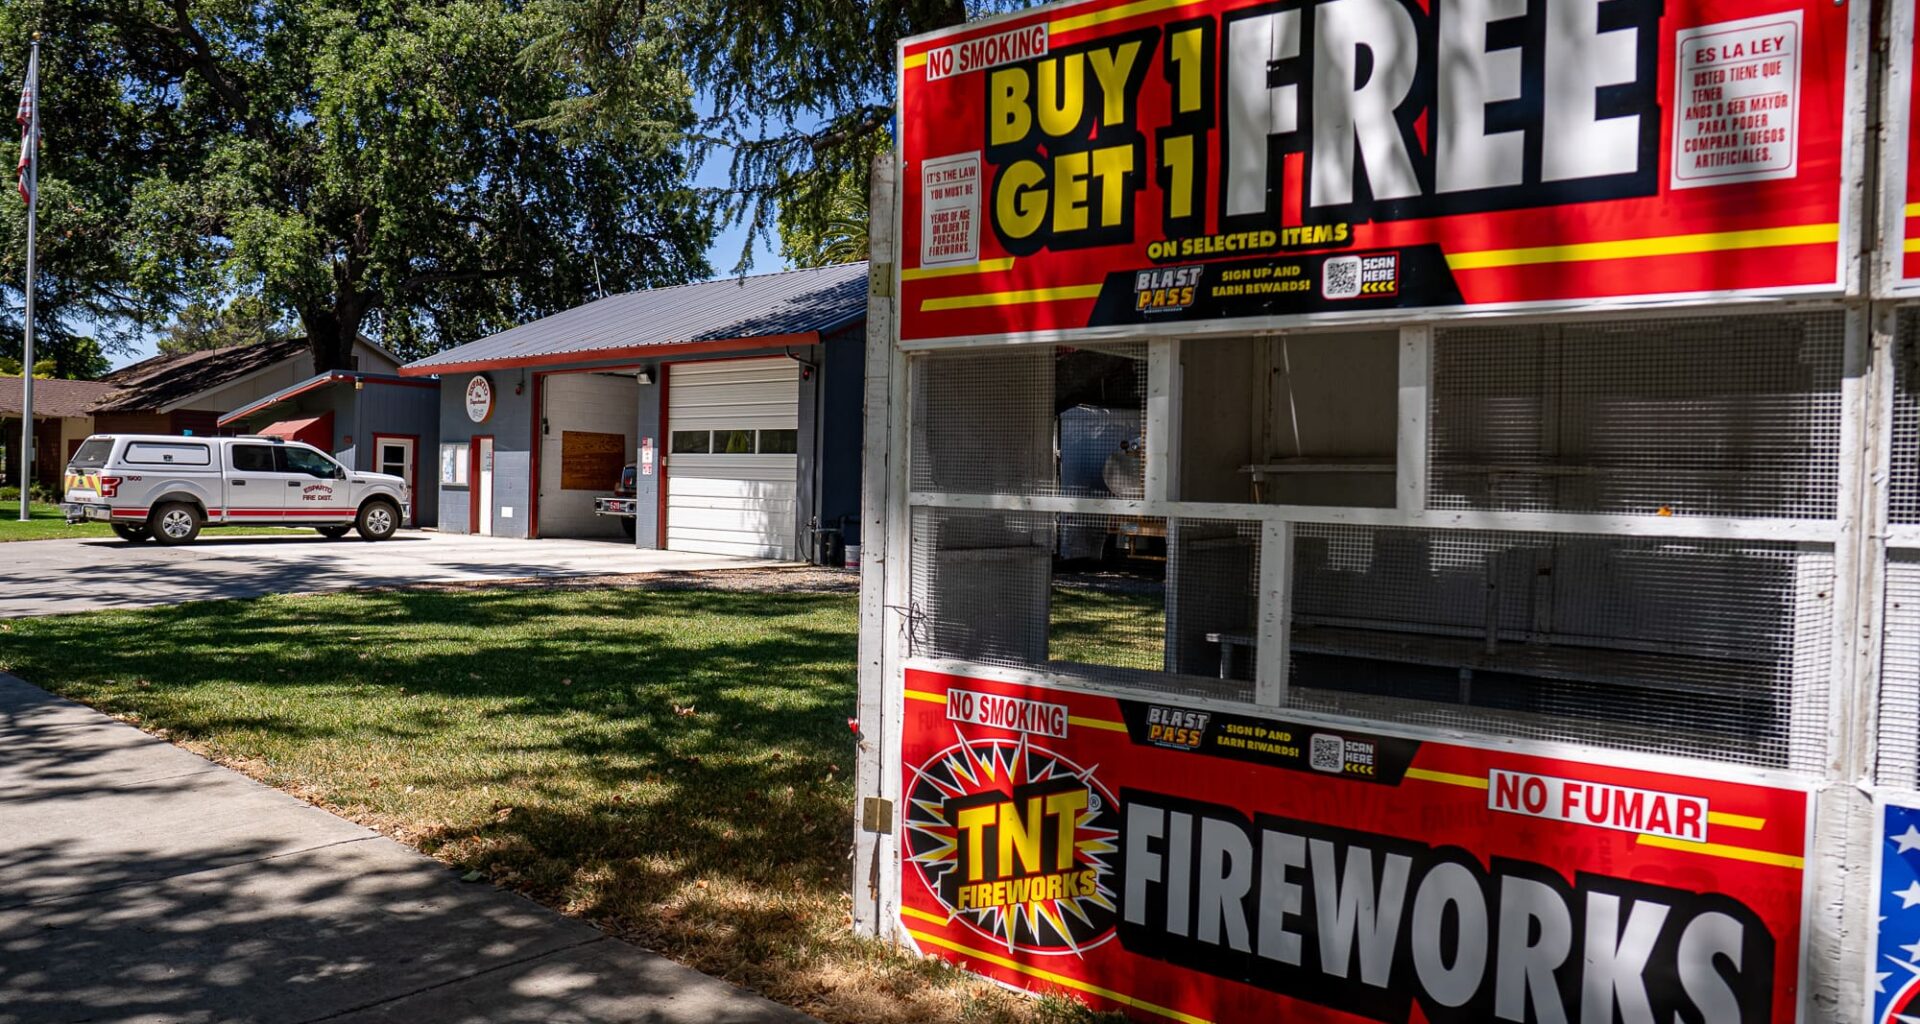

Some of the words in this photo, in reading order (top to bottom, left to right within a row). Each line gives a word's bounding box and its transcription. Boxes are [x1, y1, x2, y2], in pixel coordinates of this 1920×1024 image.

[928, 52, 954, 80] NO
[959, 27, 1045, 70] SMOKING
[1695, 47, 1716, 64] ES
[1723, 43, 1743, 59] LA
[1752, 36, 1785, 55] LEY
[1694, 70, 1725, 87] USTED
[1730, 64, 1758, 82] TIENE
[1763, 61, 1782, 79] QUE
[990, 40, 1142, 146] BUY
[1171, 27, 1203, 114] 1
[1692, 87, 1722, 103] TENER
[1226, 0, 1640, 217] FREE
[1727, 100, 1745, 116] SER
[1750, 94, 1788, 112] MAYOR
[1698, 118, 1727, 135] PARA
[1732, 114, 1768, 131] PODER
[1684, 133, 1738, 153] COMPRAR
[1743, 128, 1785, 146] FUEGOS
[927, 171, 941, 184] IT'S
[943, 169, 957, 181] THE
[959, 165, 976, 179] LAW
[931, 188, 942, 200] YOU
[945, 185, 963, 198] MUST
[966, 183, 973, 195] BE
[996, 144, 1134, 240] GET
[1163, 134, 1194, 219] 1
[930, 212, 949, 224] YEARS
[951, 210, 958, 221] OF
[959, 209, 970, 220] AGE
[933, 224, 940, 234] OR
[942, 222, 959, 233] OLDER
[961, 220, 970, 231] TO
[933, 233, 969, 245] PURCHASE
[1148, 241, 1177, 260] ON
[1181, 230, 1276, 256] SELECTED
[1281, 223, 1348, 247] ITEMS
[1222, 268, 1251, 282] SIGN
[1253, 267, 1272, 279] UP
[1273, 265, 1301, 278] AND
[1362, 256, 1395, 269] SCAN
[1136, 267, 1202, 290] BLAST
[1362, 269, 1395, 282] HERE
[1138, 287, 1194, 309] PASS
[1212, 284, 1244, 297] EARN
[1245, 279, 1311, 295] REWARDS!
[949, 691, 974, 721] NO
[979, 695, 1065, 738] SMOKING
[1148, 707, 1208, 730] BLAST
[1150, 724, 1201, 747] PASS
[1217, 735, 1245, 748] EARN
[1226, 723, 1253, 736] SIGN
[1268, 730, 1292, 742] AND
[1344, 740, 1374, 755] SCAN
[1344, 752, 1374, 766] HERE
[1495, 772, 1548, 815] NO
[1562, 782, 1702, 838] FUMAR
[958, 788, 1090, 883] TNT
[958, 869, 1097, 910] FIREWORKS
[1123, 801, 1745, 1024] FIREWORKS
